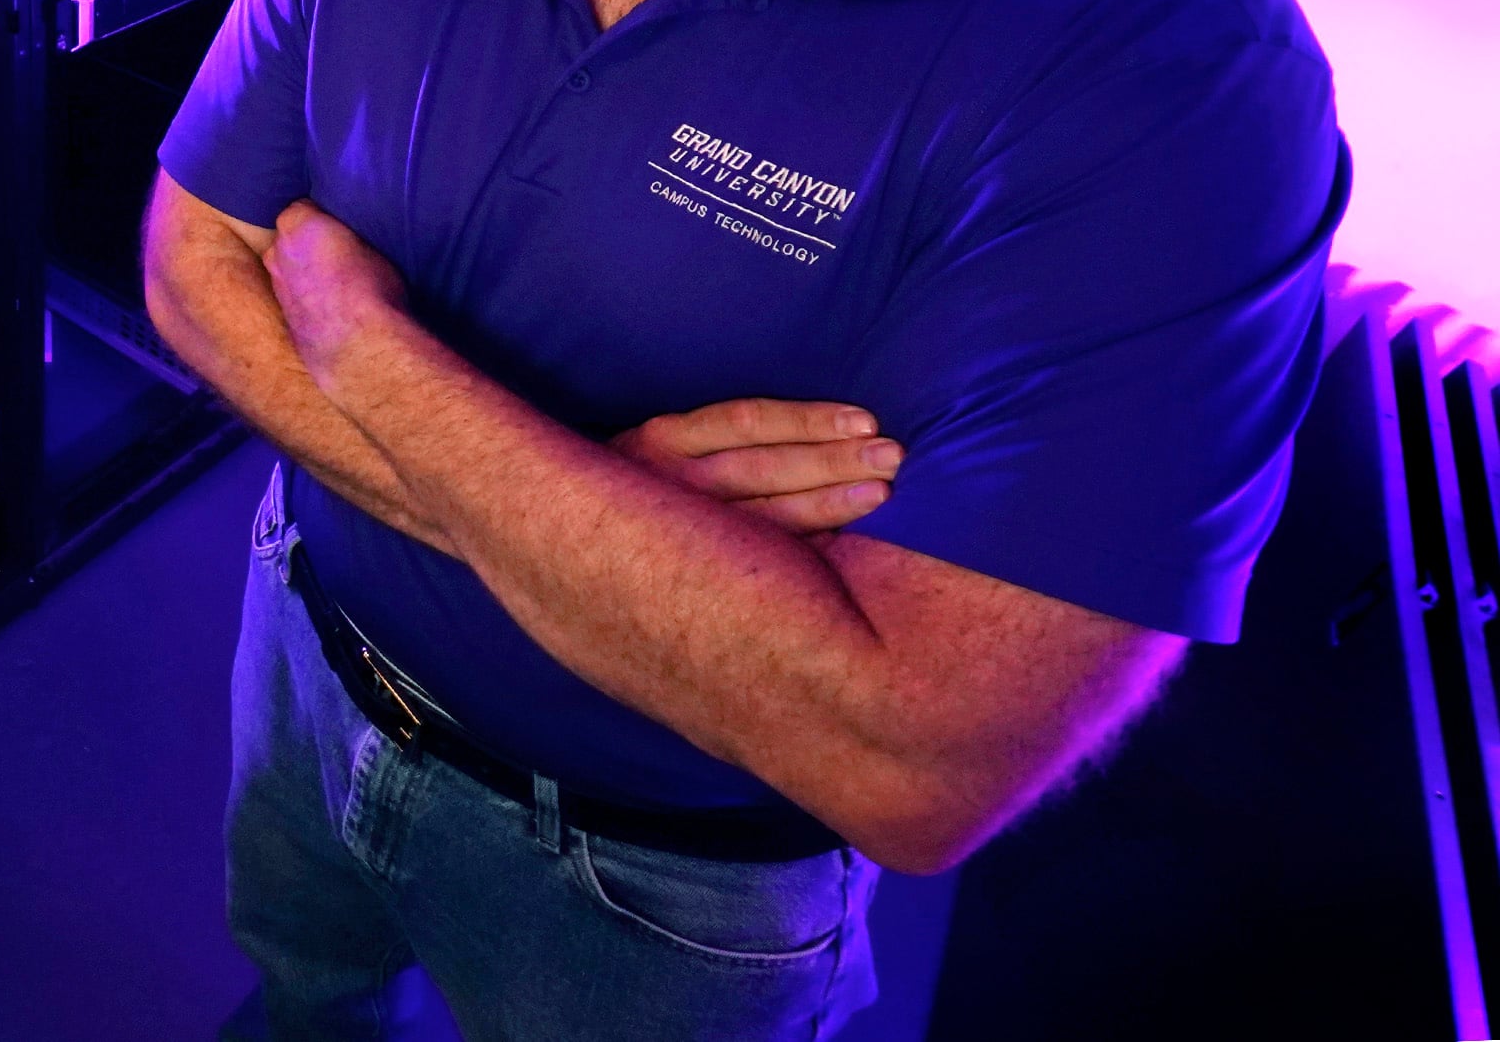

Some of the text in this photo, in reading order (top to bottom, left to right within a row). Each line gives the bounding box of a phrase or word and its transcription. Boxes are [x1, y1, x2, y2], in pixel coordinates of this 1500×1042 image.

[671, 123, 856, 213] GRAND CANYON
[650, 181, 820, 266] CAMPUS TECHNOLOGY
